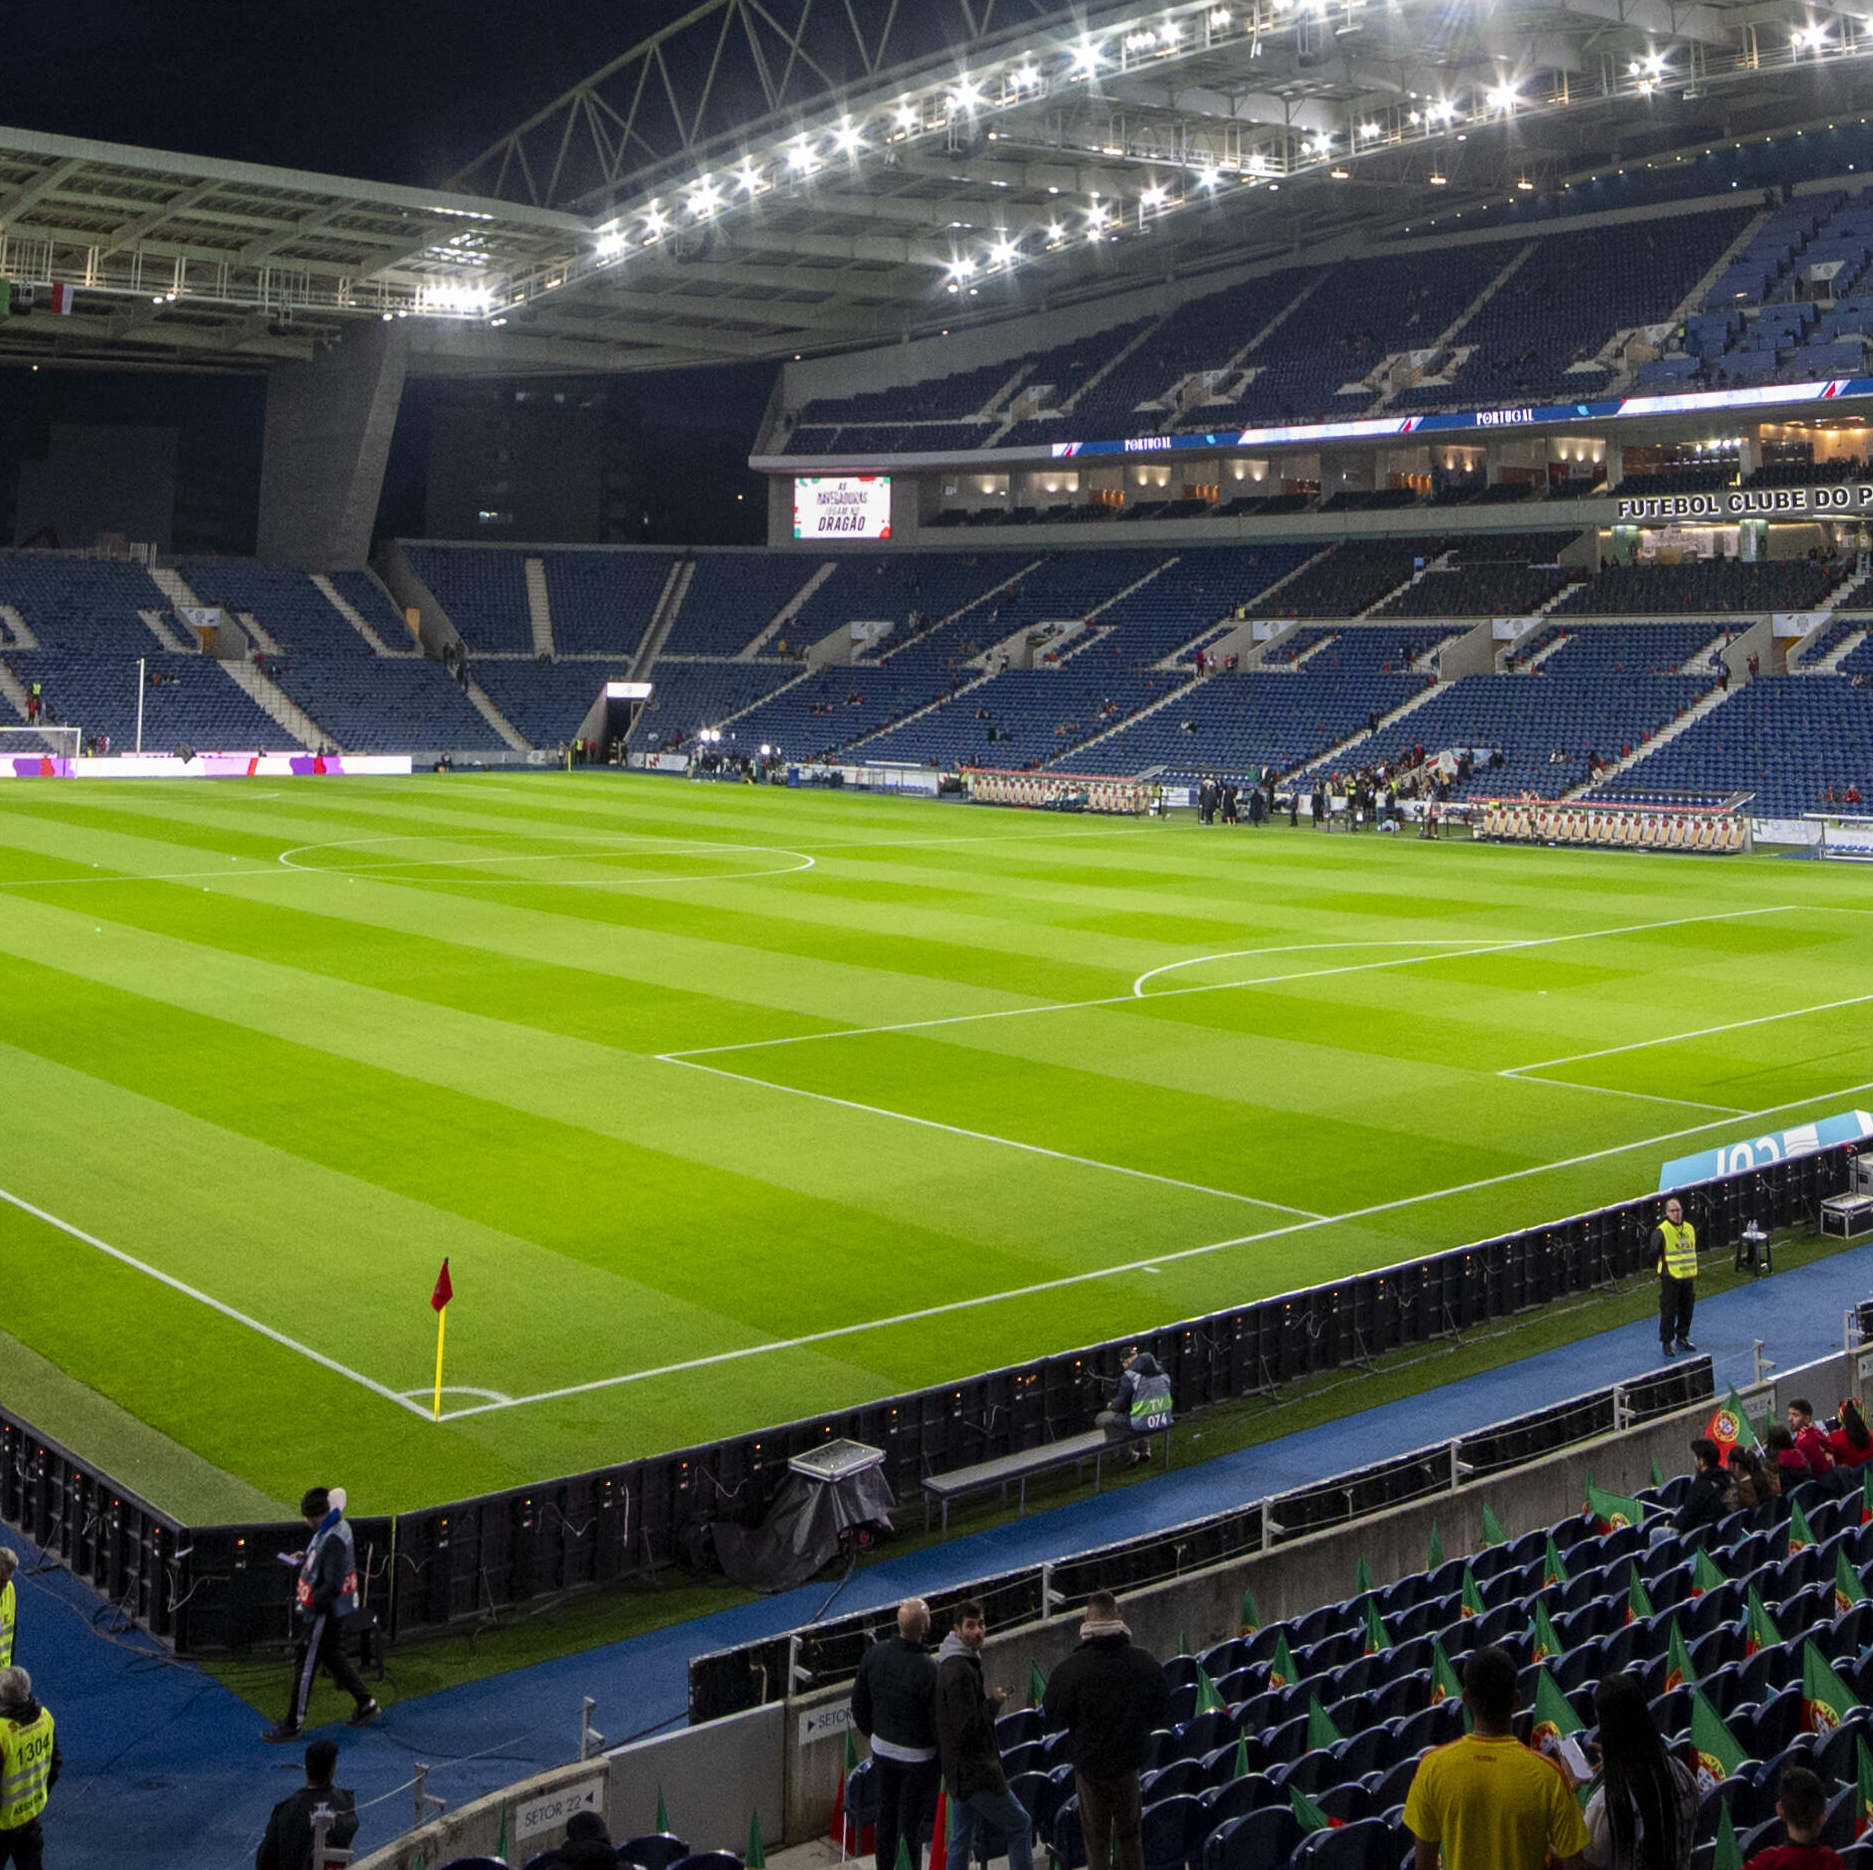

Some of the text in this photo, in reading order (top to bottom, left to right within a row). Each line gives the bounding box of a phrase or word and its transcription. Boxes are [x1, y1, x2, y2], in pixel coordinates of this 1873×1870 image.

[1476, 408, 1534, 426] PORTUGAL
[1125, 436, 1172, 451] PORTUGAL
[1618, 495, 1720, 518] FUTEBOL
[1728, 488, 1806, 512] CLUBE
[1814, 486, 1850, 508] DO
[818, 514, 866, 531] DRAGÃO
[1150, 1397, 1164, 1411] TV
[1147, 1412, 1167, 1428] 074
[16, 1733, 50, 1766] 1304
[526, 1795, 581, 1828] SETOR 22
